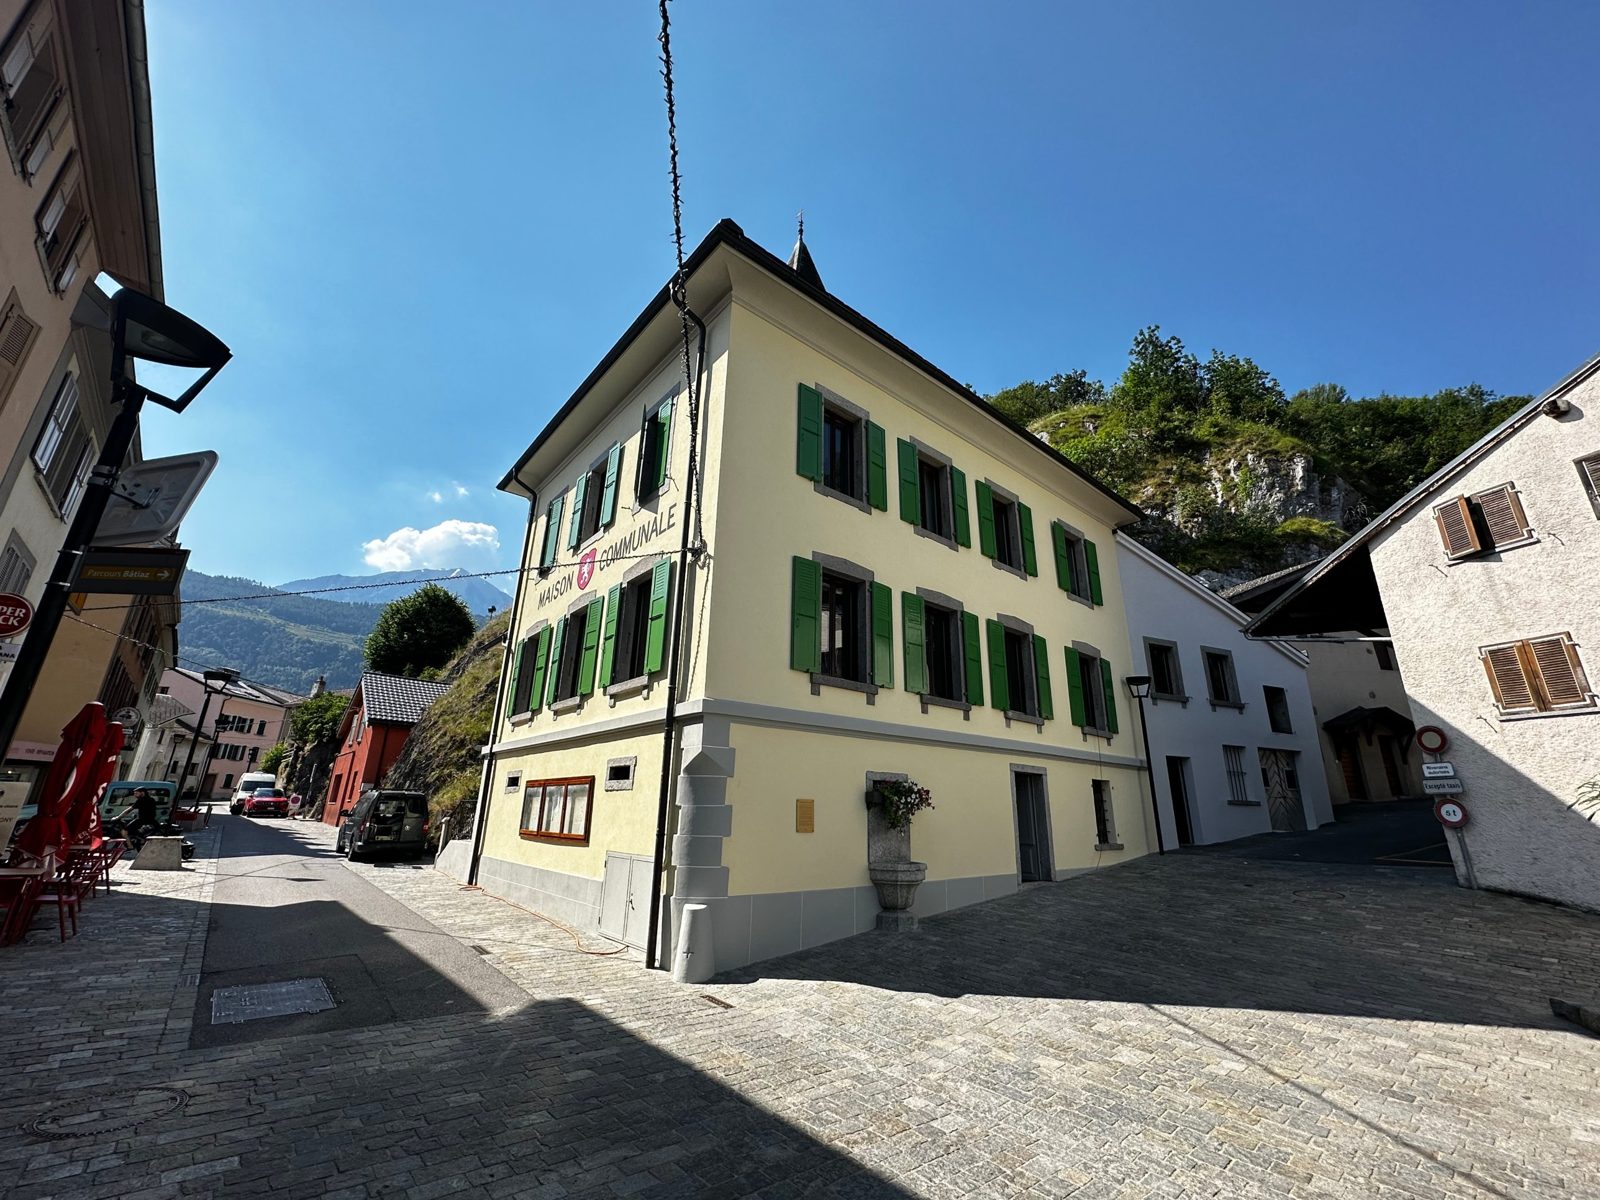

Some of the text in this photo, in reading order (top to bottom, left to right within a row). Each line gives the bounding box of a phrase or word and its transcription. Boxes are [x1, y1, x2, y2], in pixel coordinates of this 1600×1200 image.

[538, 503, 677, 610] MAISON COMMUNALE
[87, 569, 150, 578] Parcours Bâtiaz
[1445, 809, 1451, 817] 5
